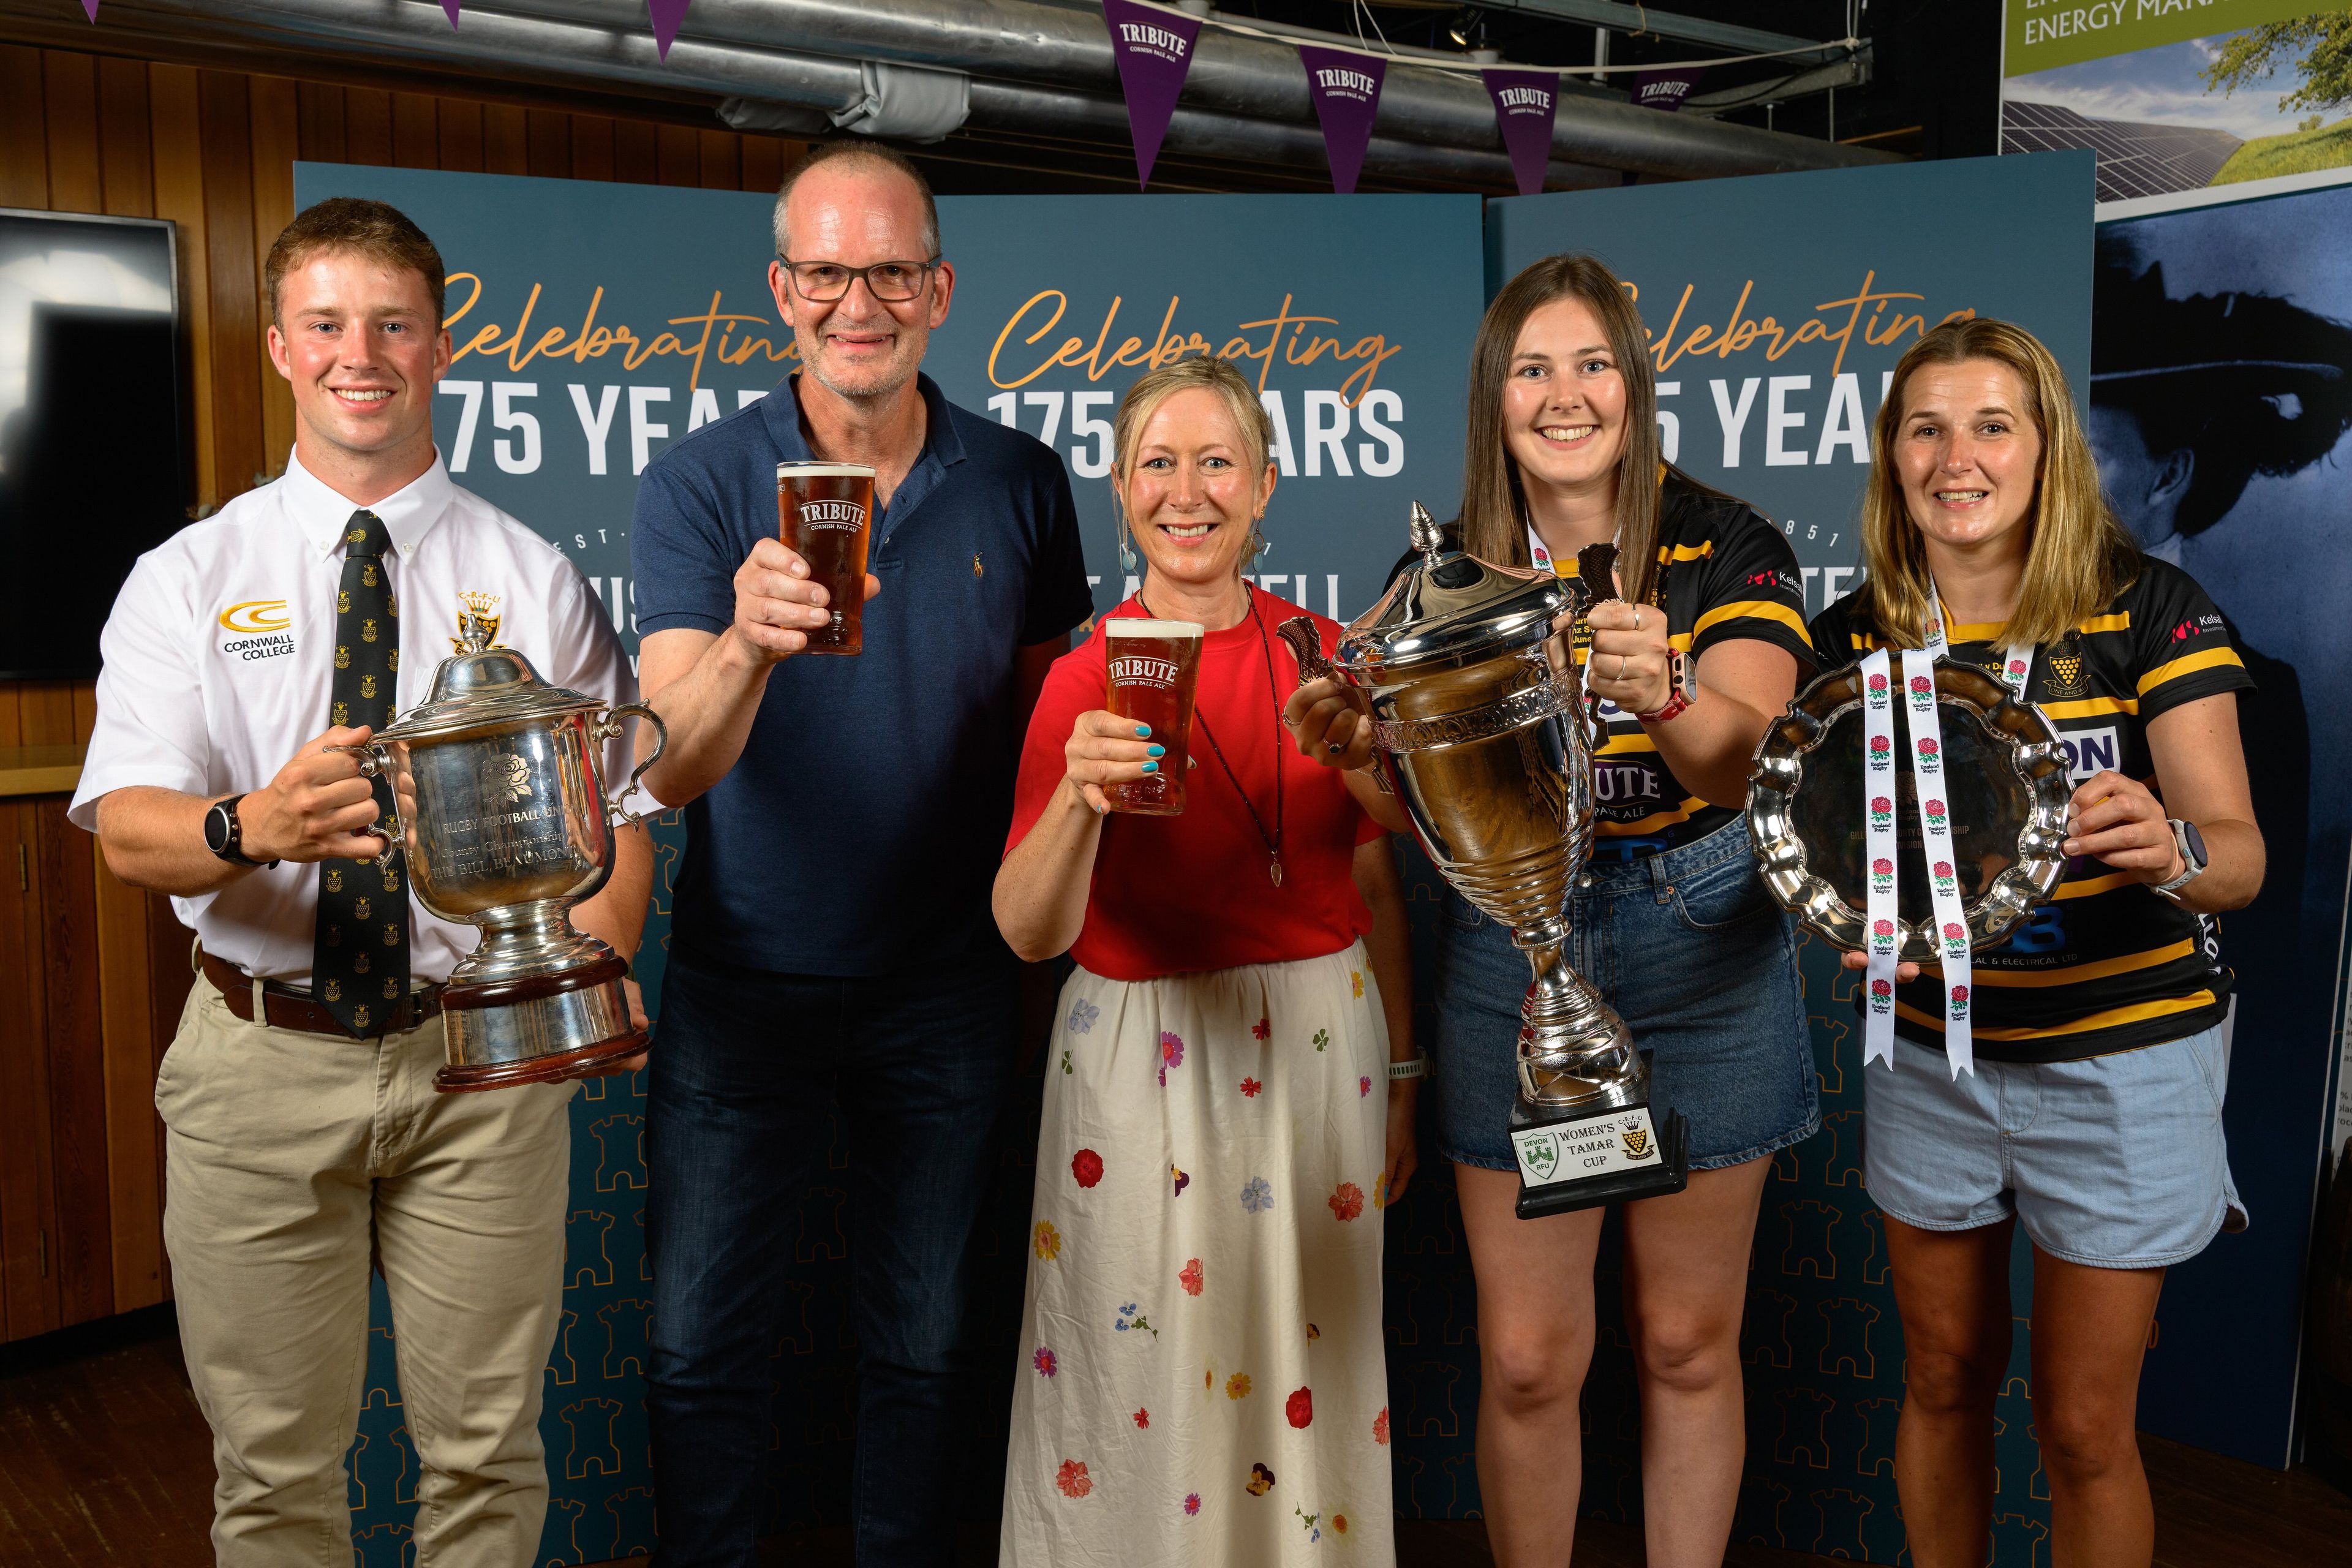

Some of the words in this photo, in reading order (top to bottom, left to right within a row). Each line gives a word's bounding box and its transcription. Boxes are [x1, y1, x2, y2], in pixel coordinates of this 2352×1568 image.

[2025, 0, 2127, 45] ENERGY
[1119, 23, 1187, 56] TRIBUTE
[1316, 69, 1374, 96] TRIBUTE
[1640, 81, 1691, 98] TRIBUTE
[1498, 88, 1550, 109] TRIBUTE
[987, 289, 1403, 409] Celebrating
[1709, 371, 1894, 468] YEA
[800, 503, 865, 526] TRIBUTE
[224, 635, 294, 652] CORNWALL
[243, 644, 295, 661] COLLEGE
[1109, 659, 1178, 682] TRIBUTE
[443, 818, 478, 834] RUGBY
[483, 809, 541, 828] FOOTBALL
[1595, 807, 1618, 818] PALE
[1623, 806, 1645, 819] ALE
[441, 844, 480, 858] County
[484, 831, 564, 852] Championship
[1850, 831, 1864, 840] GILL
[432, 865, 454, 879] THE
[458, 861, 489, 876] BILL
[493, 846, 576, 869] BEAUMONT
[2062, 954, 2078, 962] LTD
[1618, 1115, 1643, 1125] C-R-F-U
[1559, 1123, 1615, 1141] WOMEN'S
[1524, 1137, 1548, 1147] DEVON
[1567, 1139, 1615, 1155] TAMAR
[1583, 1156, 1607, 1167] CUP
